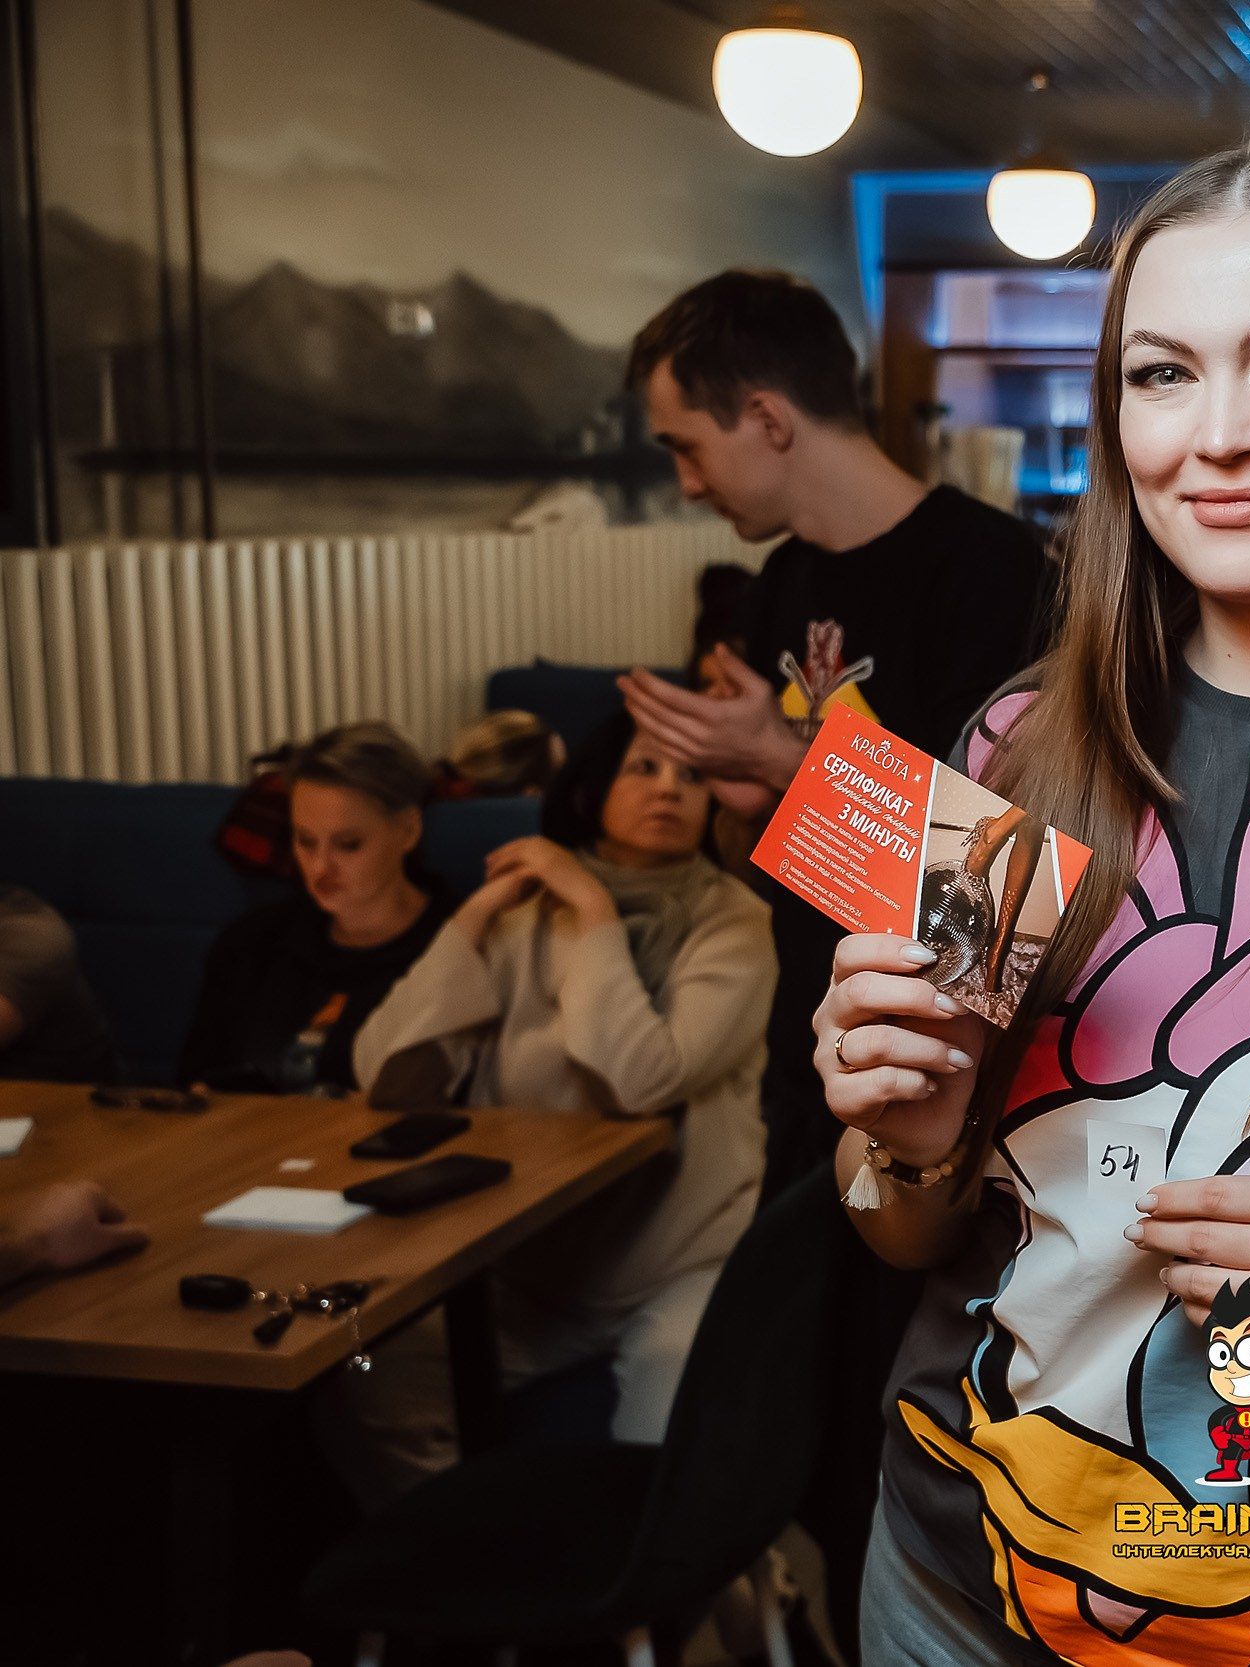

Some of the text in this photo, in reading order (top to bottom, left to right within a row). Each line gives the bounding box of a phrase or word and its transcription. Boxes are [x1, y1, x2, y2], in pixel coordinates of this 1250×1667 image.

[850, 734, 909, 781] КРАСОТА
[823, 753, 914, 817] СЕРТИФИКАТ
[819, 828, 849, 850] ассортимент
[847, 847, 866, 862] кремов
[837, 803, 917, 863] 3 МИНУТЫ
[856, 839, 875, 854] городе
[829, 860, 846, 875] пакете
[873, 888, 901, 911] бесплатно
[847, 860, 868, 876] защиты
[1100, 1144, 1140, 1182] 54
